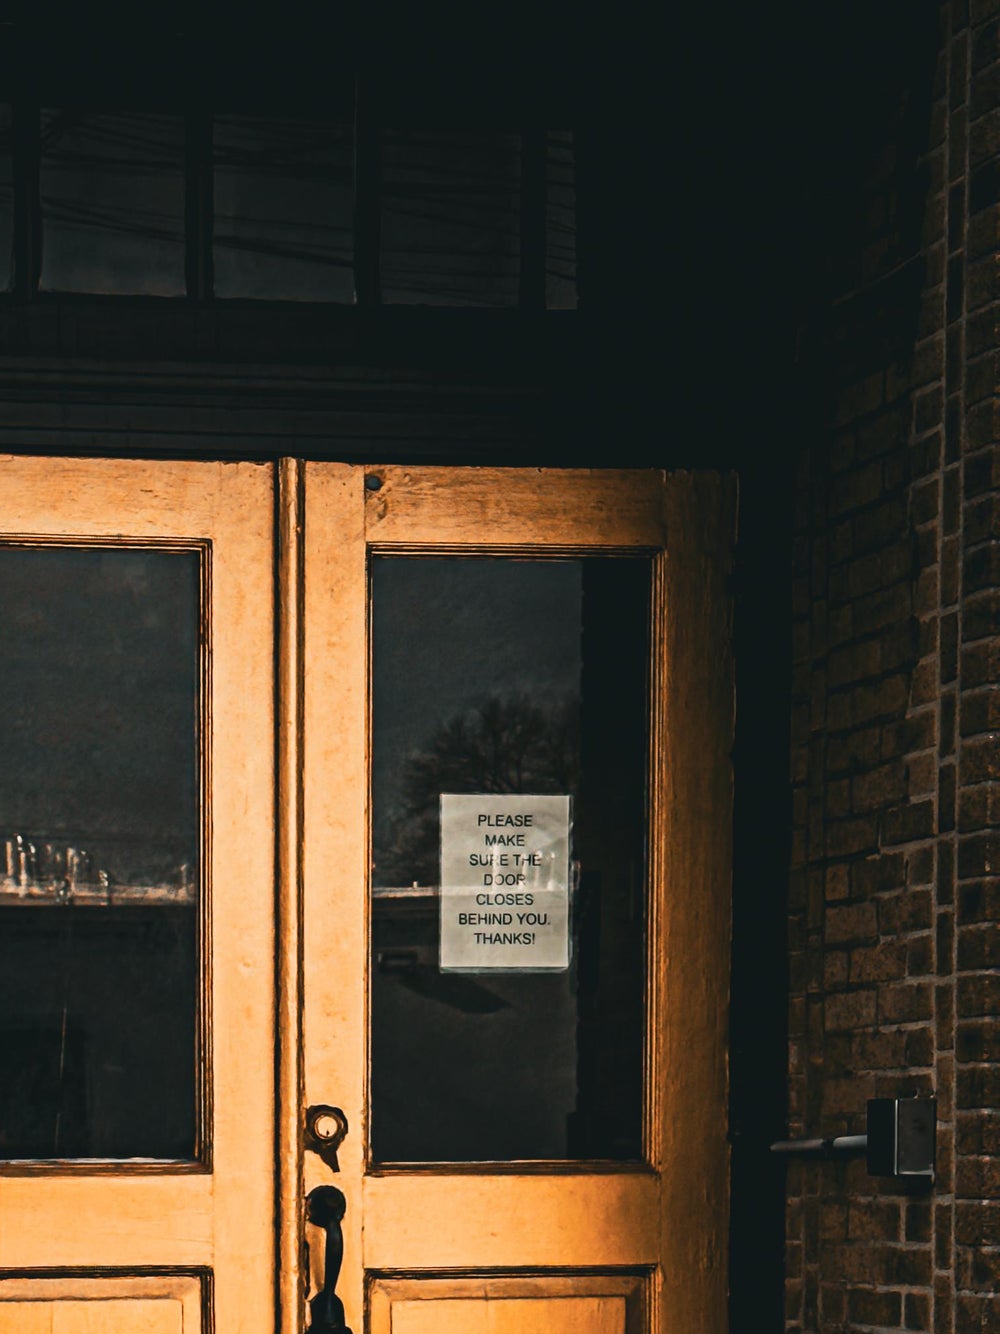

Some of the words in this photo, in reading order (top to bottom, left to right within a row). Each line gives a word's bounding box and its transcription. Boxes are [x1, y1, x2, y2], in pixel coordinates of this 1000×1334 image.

[478, 814, 533, 827] PLEASE
[485, 834, 525, 846] MAKE
[514, 854, 542, 866] THE
[484, 874, 526, 886] DOOR
[476, 893, 534, 906] CLOSES
[459, 913, 512, 925] BEHIND
[516, 913, 550, 925] YOU.
[474, 932, 535, 944] THANKS!
